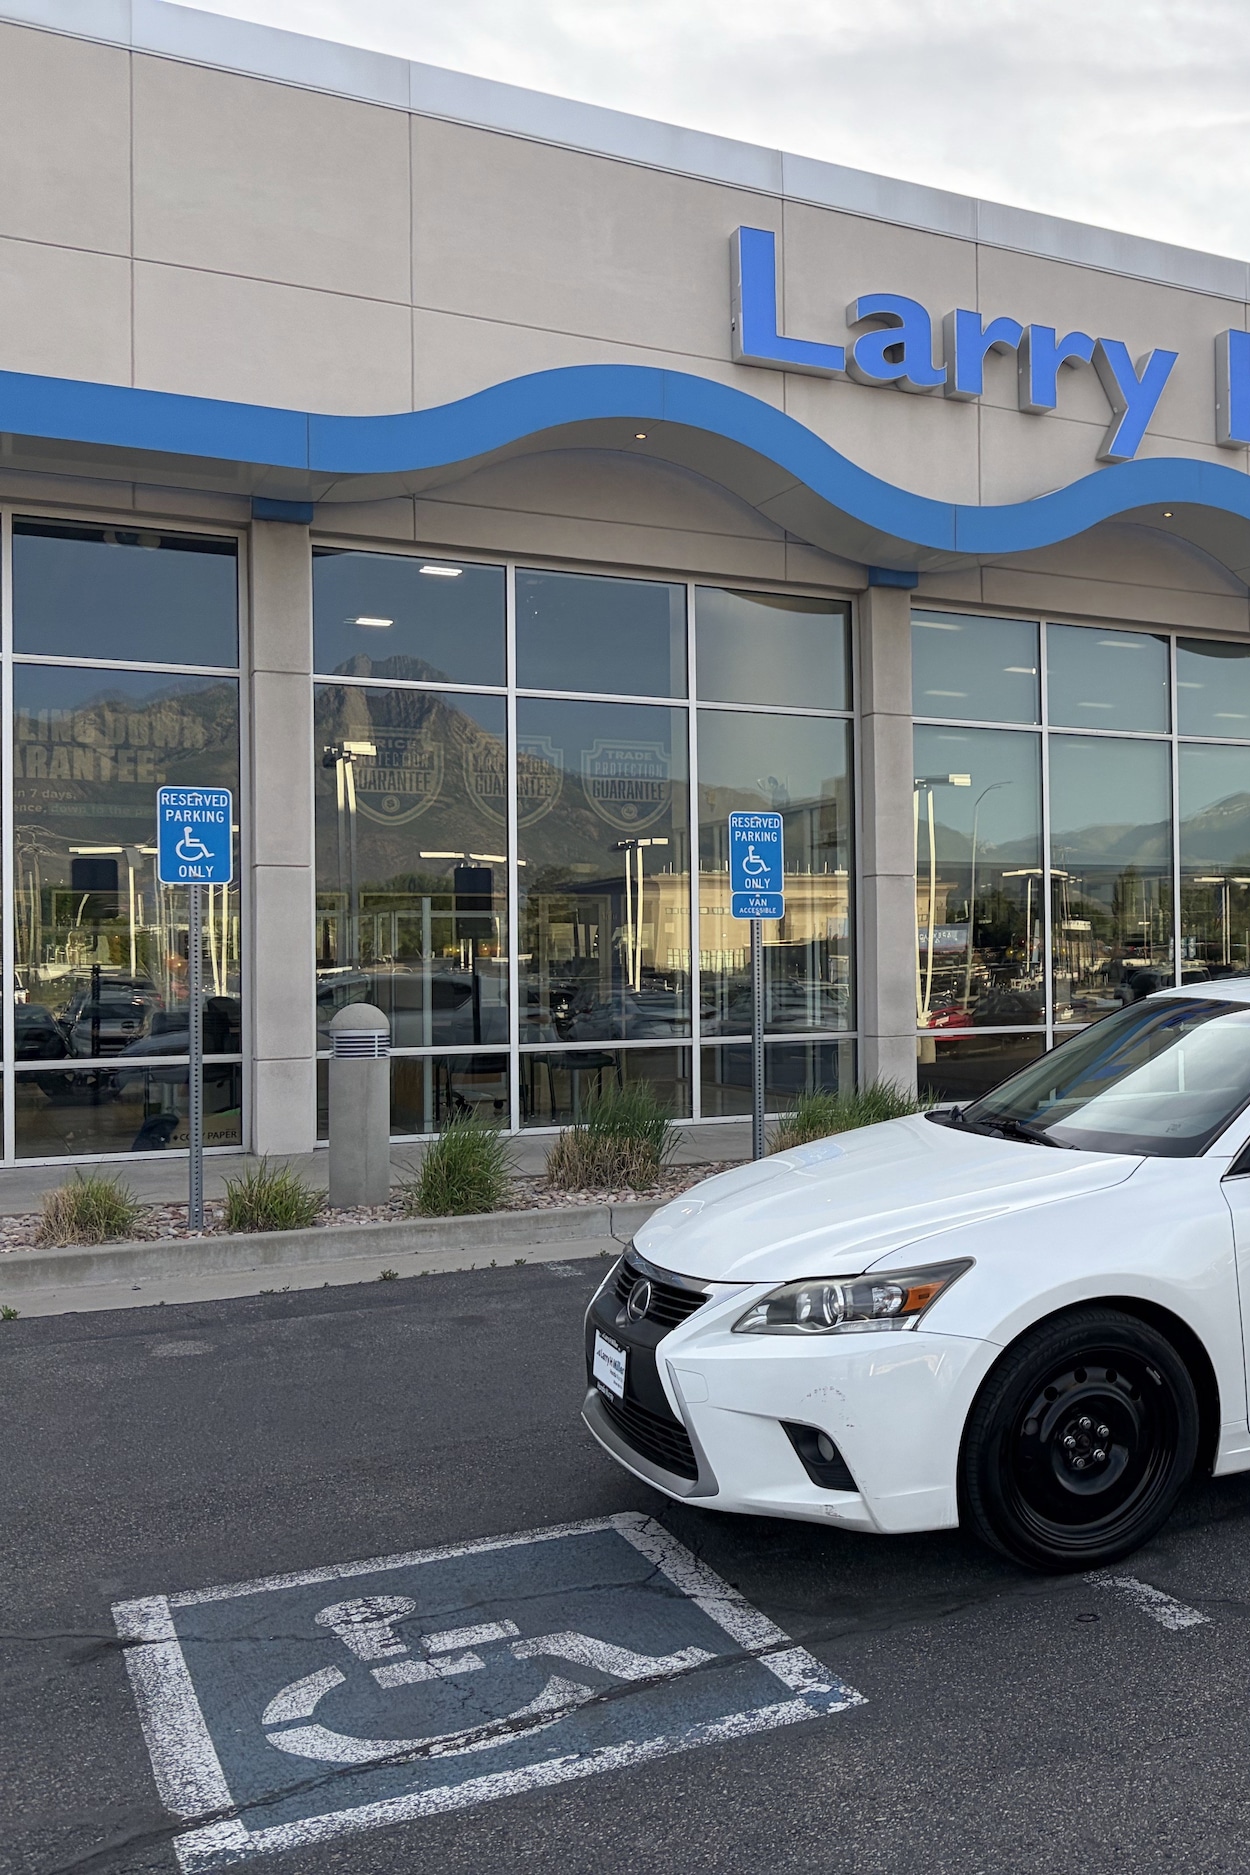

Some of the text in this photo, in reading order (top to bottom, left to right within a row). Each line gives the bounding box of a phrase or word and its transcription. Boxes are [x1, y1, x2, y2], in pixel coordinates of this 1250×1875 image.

[734, 225, 1179, 462] Larry
[375, 739, 417, 749] RICE
[605, 751, 652, 760] TRADE
[595, 762, 662, 777] PROTECTION
[30, 788, 38, 798] 7
[592, 779, 665, 800] GUARANTEE
[161, 793, 228, 807] RESERVED
[165, 809, 225, 823] PARKING
[732, 816, 780, 829] RESERVED
[735, 831, 778, 842] PARKING
[178, 865, 214, 878] ONLY
[744, 878, 771, 889] ONLY
[748, 898, 767, 907] VAN
[207, 1131, 237, 1139] PAPER
